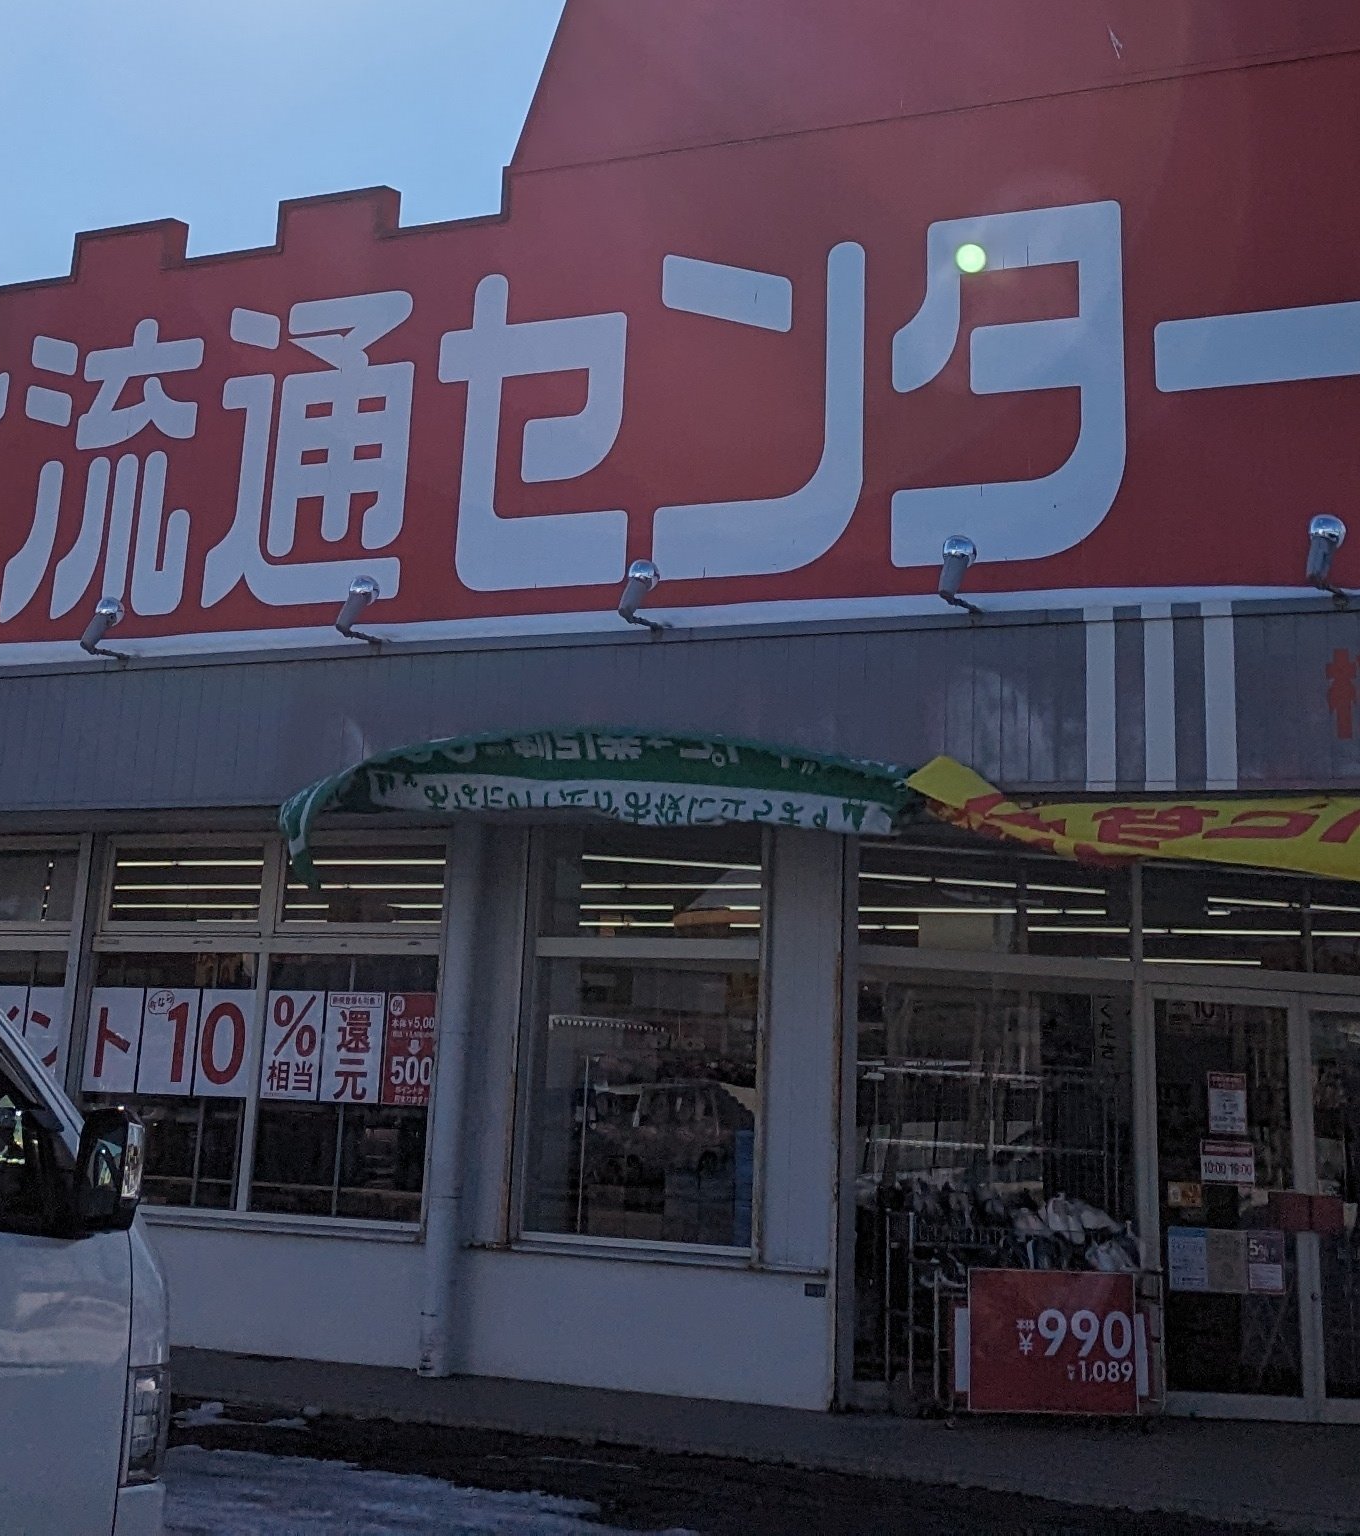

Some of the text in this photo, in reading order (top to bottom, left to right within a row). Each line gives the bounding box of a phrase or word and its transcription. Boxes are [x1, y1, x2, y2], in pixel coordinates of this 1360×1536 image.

[333, 1010, 371, 1101] 還元
[390, 1056, 433, 1086] 500
[268, 1060, 314, 1093] 相当
